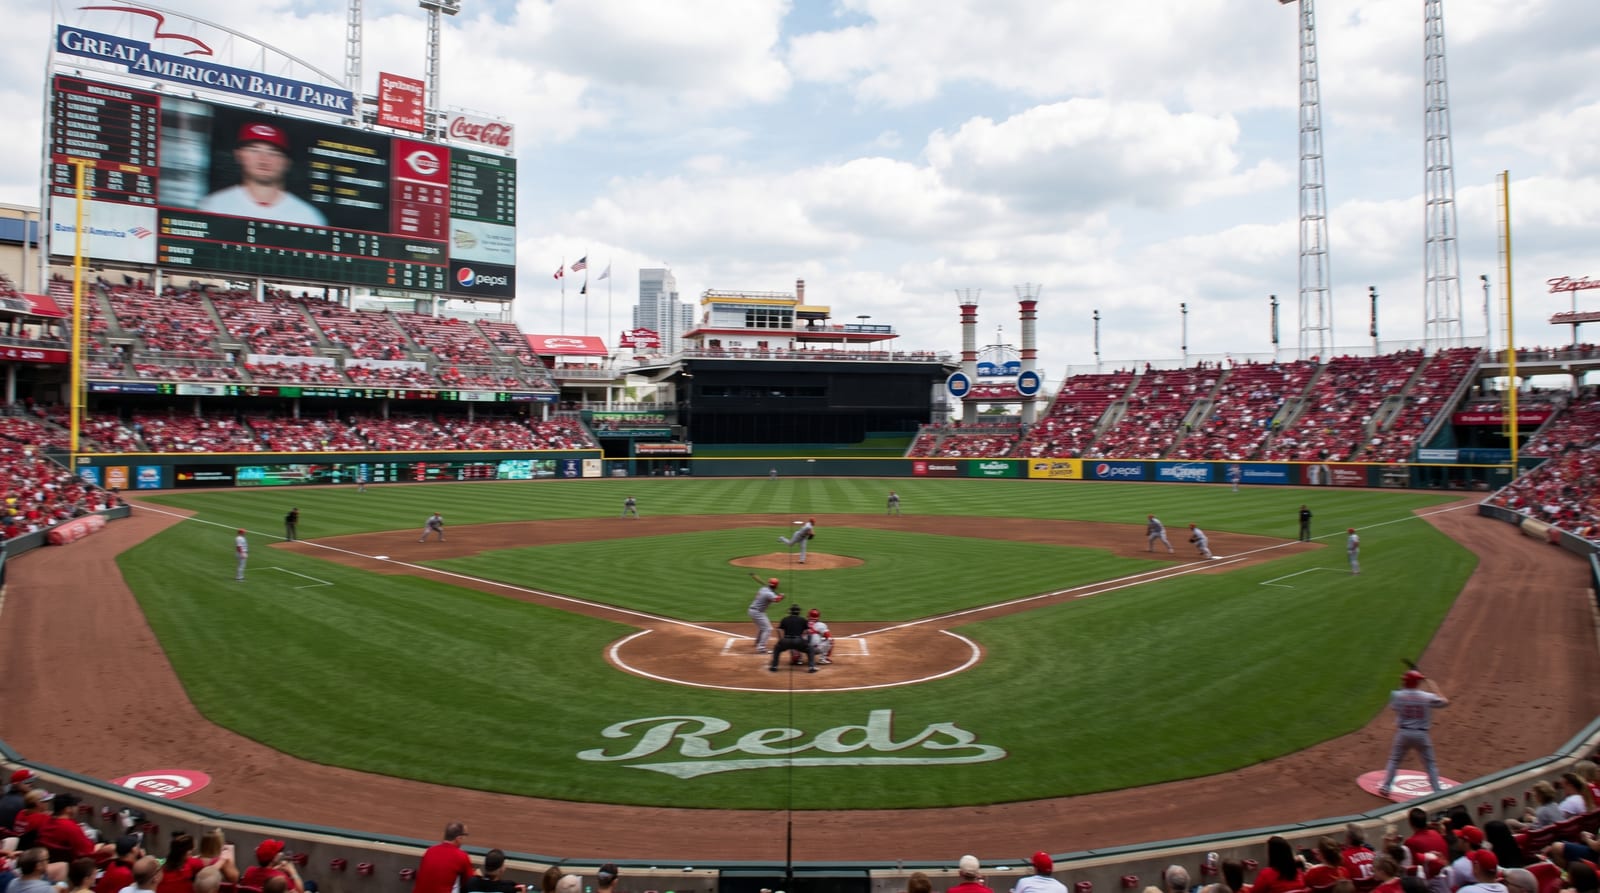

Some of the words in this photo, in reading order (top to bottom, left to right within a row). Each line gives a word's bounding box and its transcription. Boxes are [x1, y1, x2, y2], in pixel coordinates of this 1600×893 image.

[61, 30, 140, 62] GREAT
[133, 53, 245, 90] AMERICAN
[248, 76, 297, 101] BALL
[298, 86, 349, 110] PARK
[89, 227, 126, 238] America
[475, 274, 508, 286] pepsi
[1110, 465, 1142, 477] pepsi
[576, 708, 1007, 779] Reds
[139, 780, 184, 793] REDS
